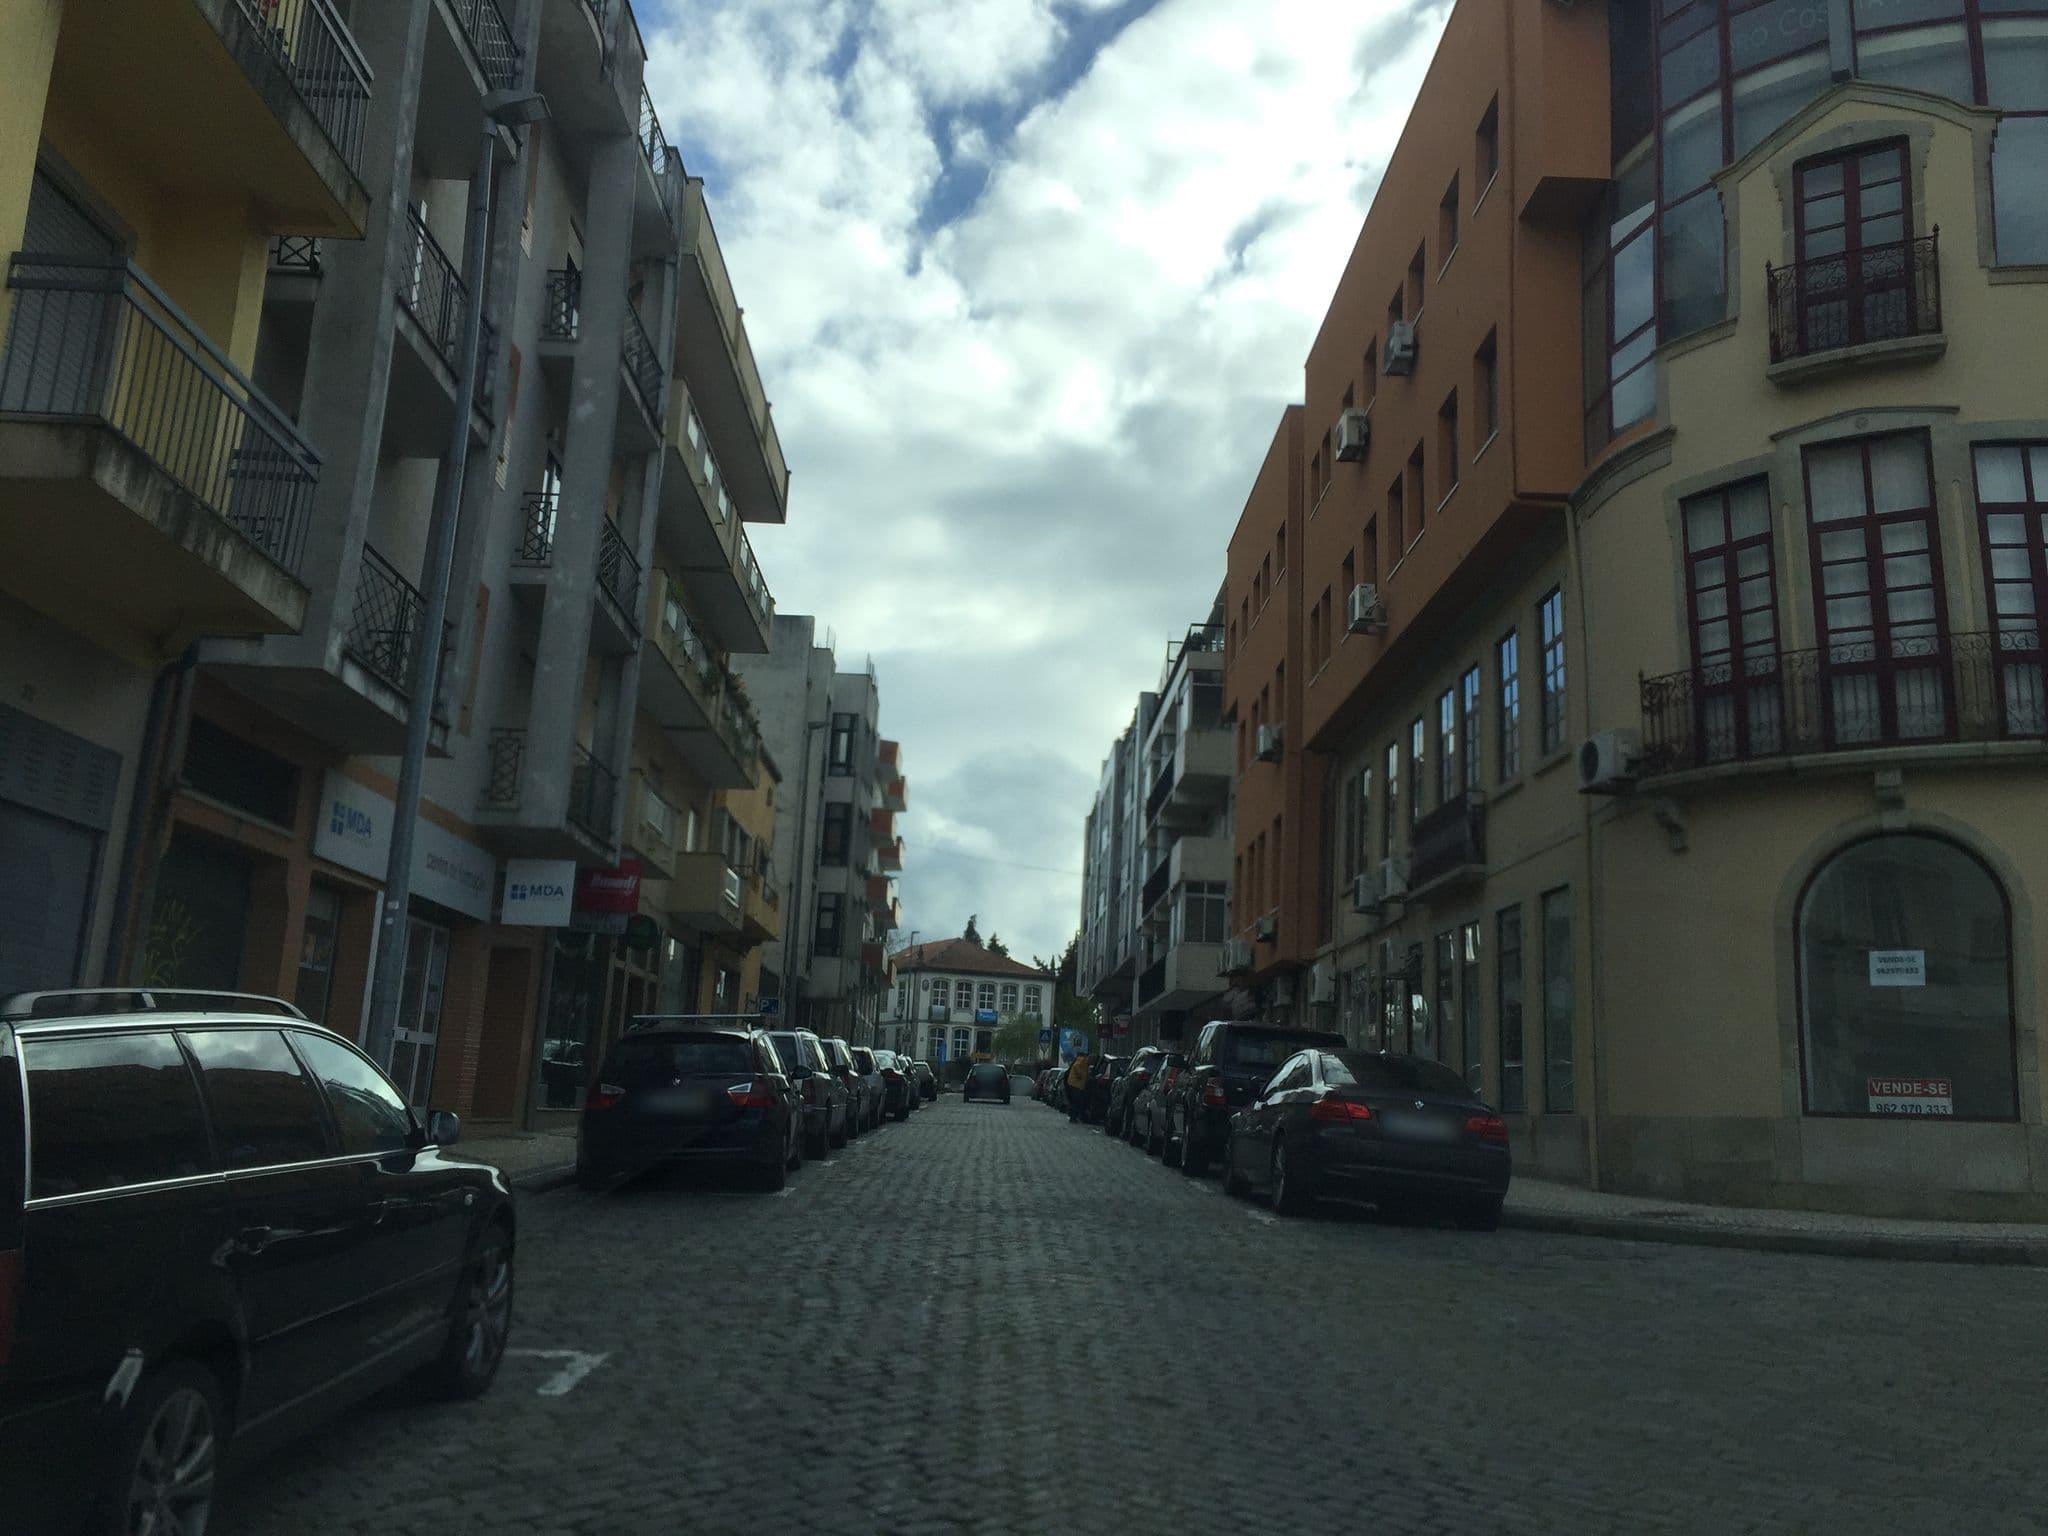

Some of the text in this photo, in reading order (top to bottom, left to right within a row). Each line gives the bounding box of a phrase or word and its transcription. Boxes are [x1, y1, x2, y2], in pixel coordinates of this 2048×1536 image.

[346, 807, 372, 839] MDA
[529, 884, 564, 897] MDA
[1872, 1082, 1948, 1095] VENDE-SE
